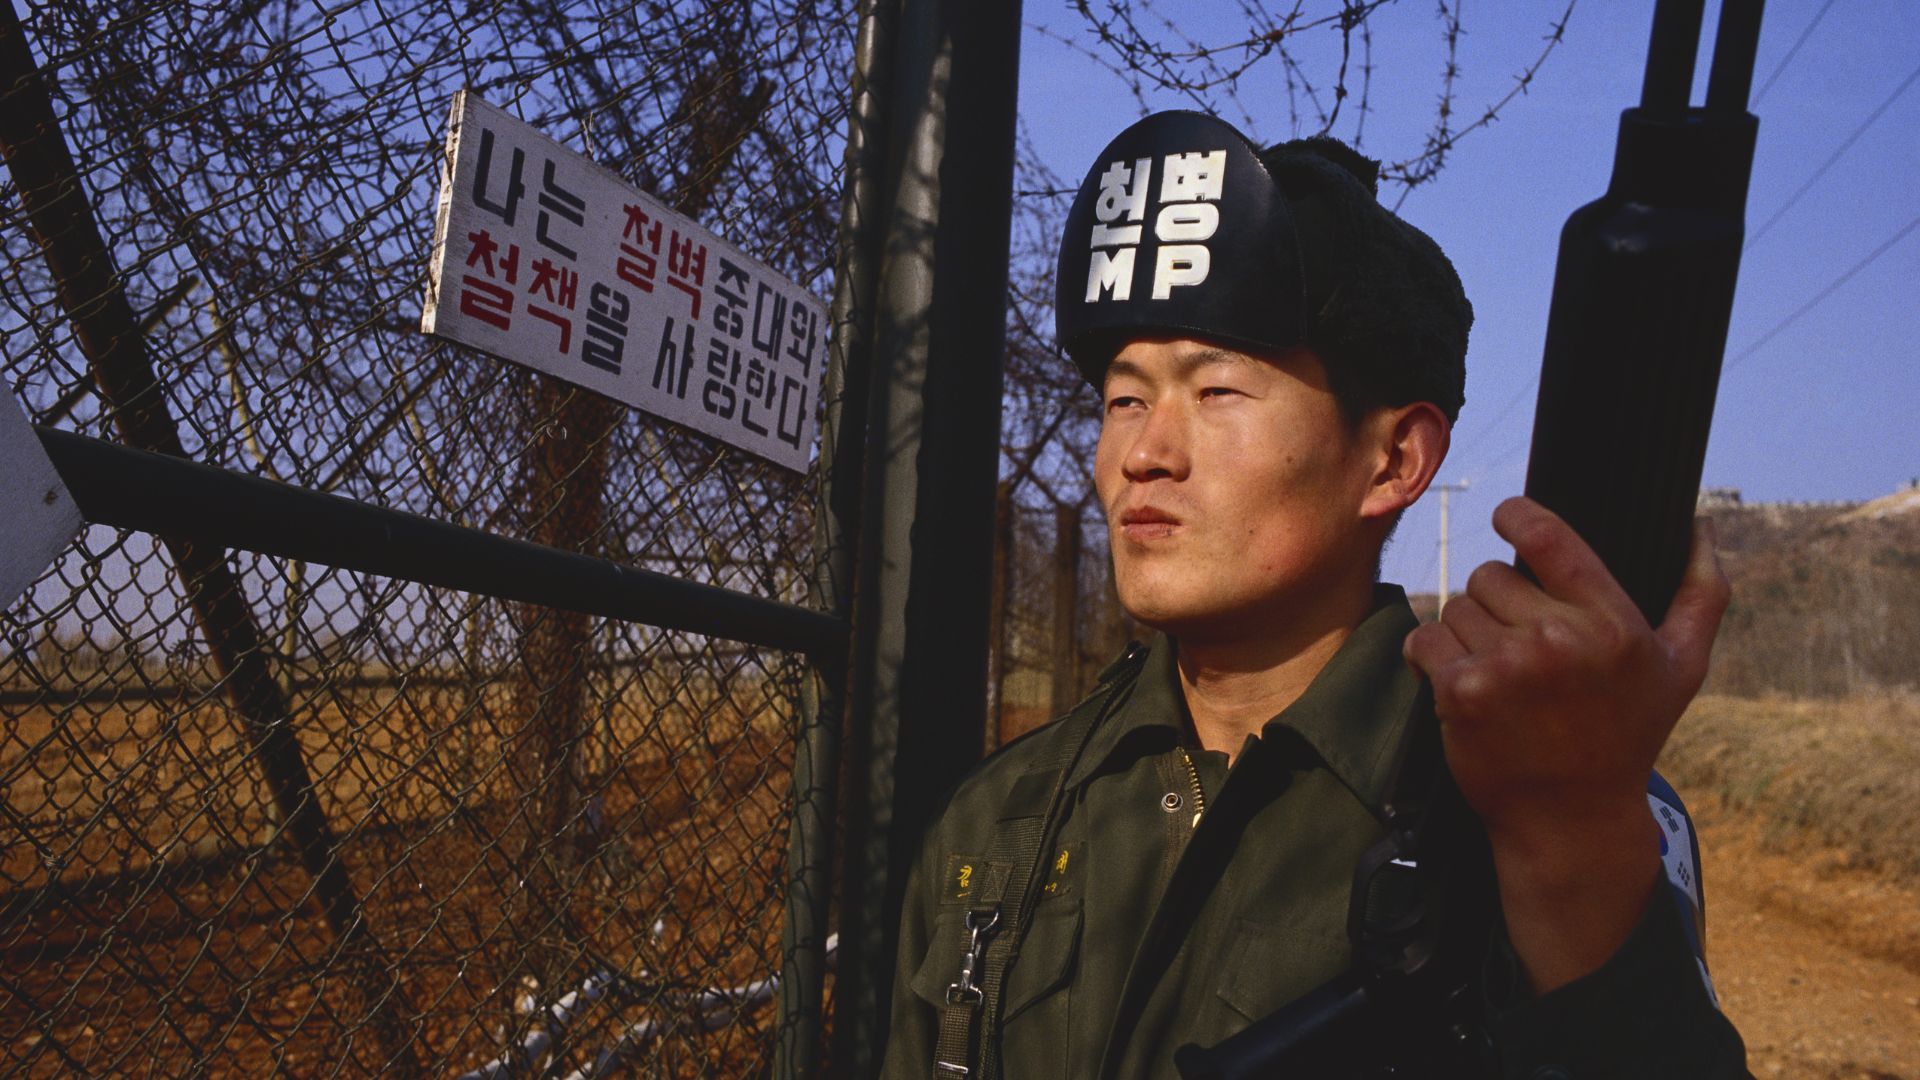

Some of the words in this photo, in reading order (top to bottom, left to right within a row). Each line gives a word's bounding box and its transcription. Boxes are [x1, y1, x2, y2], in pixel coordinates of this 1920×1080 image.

[472, 127, 586, 262] 나는
[1091, 149, 1227, 249] 헌병
[1085, 245, 1210, 303] MP
[460, 229, 630, 375] 철책을
[652, 316, 808, 450] 사랑한다
